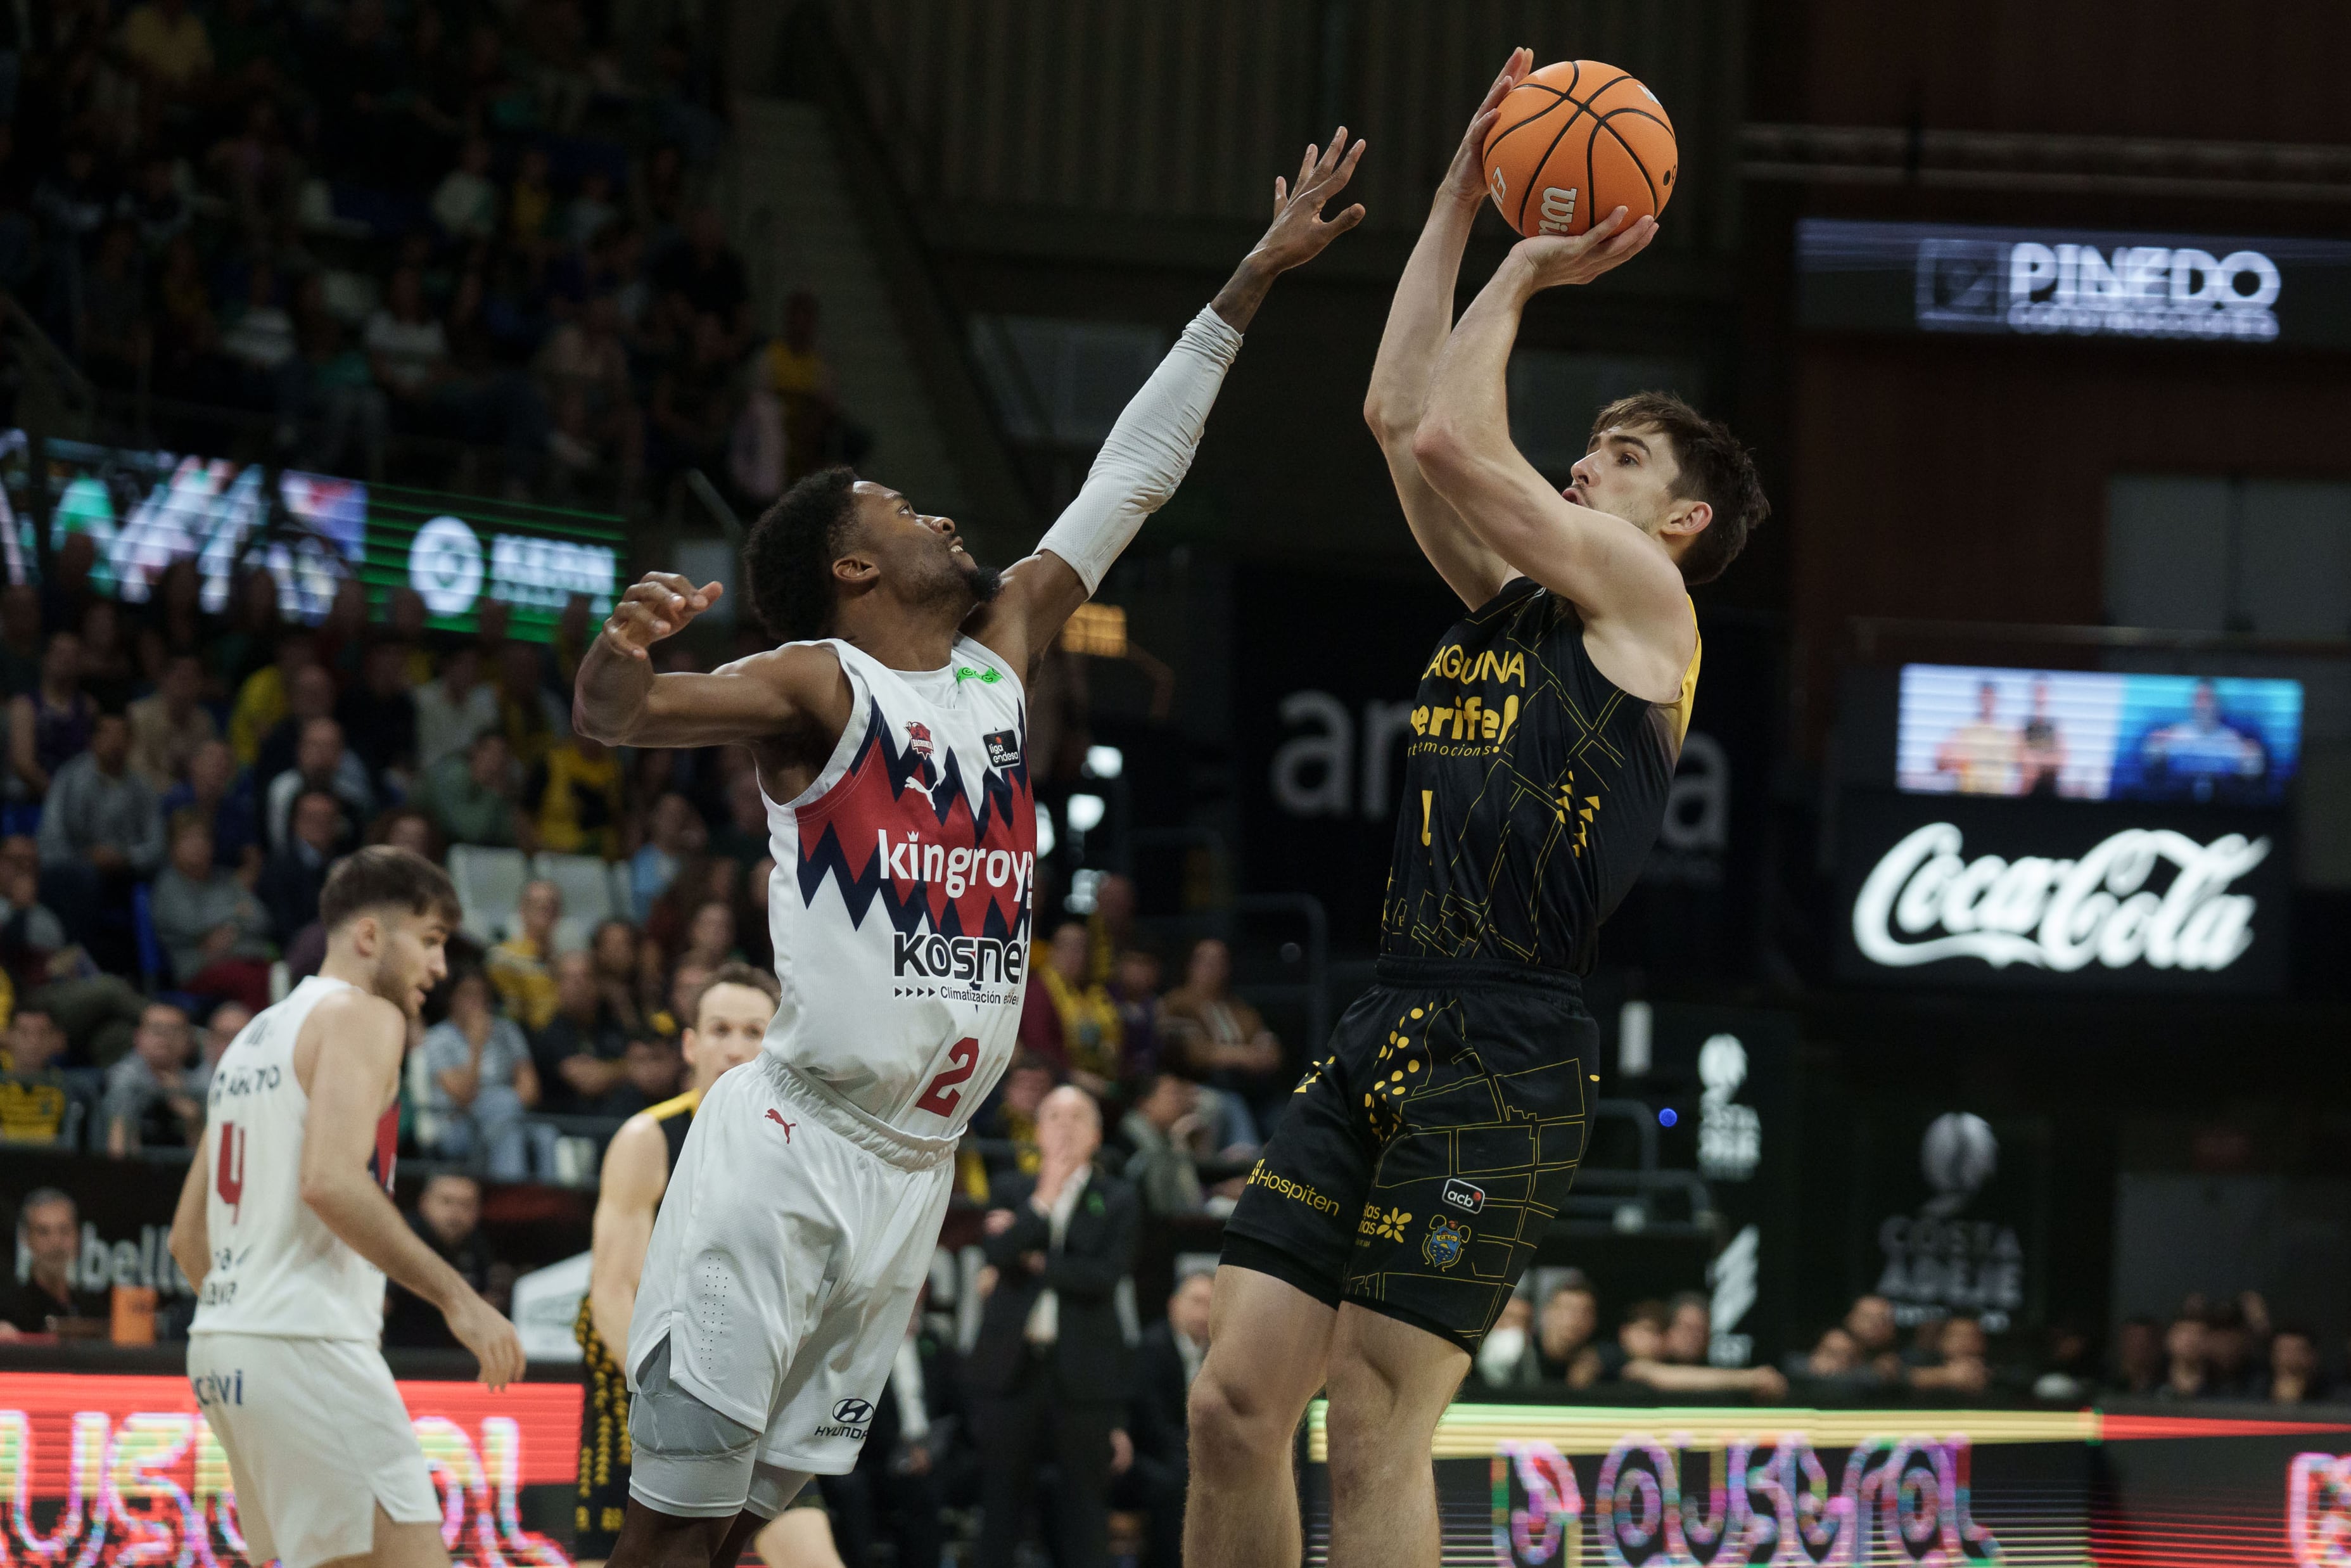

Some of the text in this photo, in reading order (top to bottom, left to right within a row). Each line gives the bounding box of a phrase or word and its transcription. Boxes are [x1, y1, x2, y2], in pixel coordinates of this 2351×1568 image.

[2009, 242, 2281, 305] PINEDO
[988, 743, 1003, 755] liga
[993, 751, 1019, 763] endesa
[1851, 822, 2273, 972] Coca-Cola
[940, 986, 1001, 1004] Climatización
[915, 1036, 979, 1118] 2
[1256, 1169, 1339, 1216] Hospiten
[1448, 1190, 1474, 1208] acb
